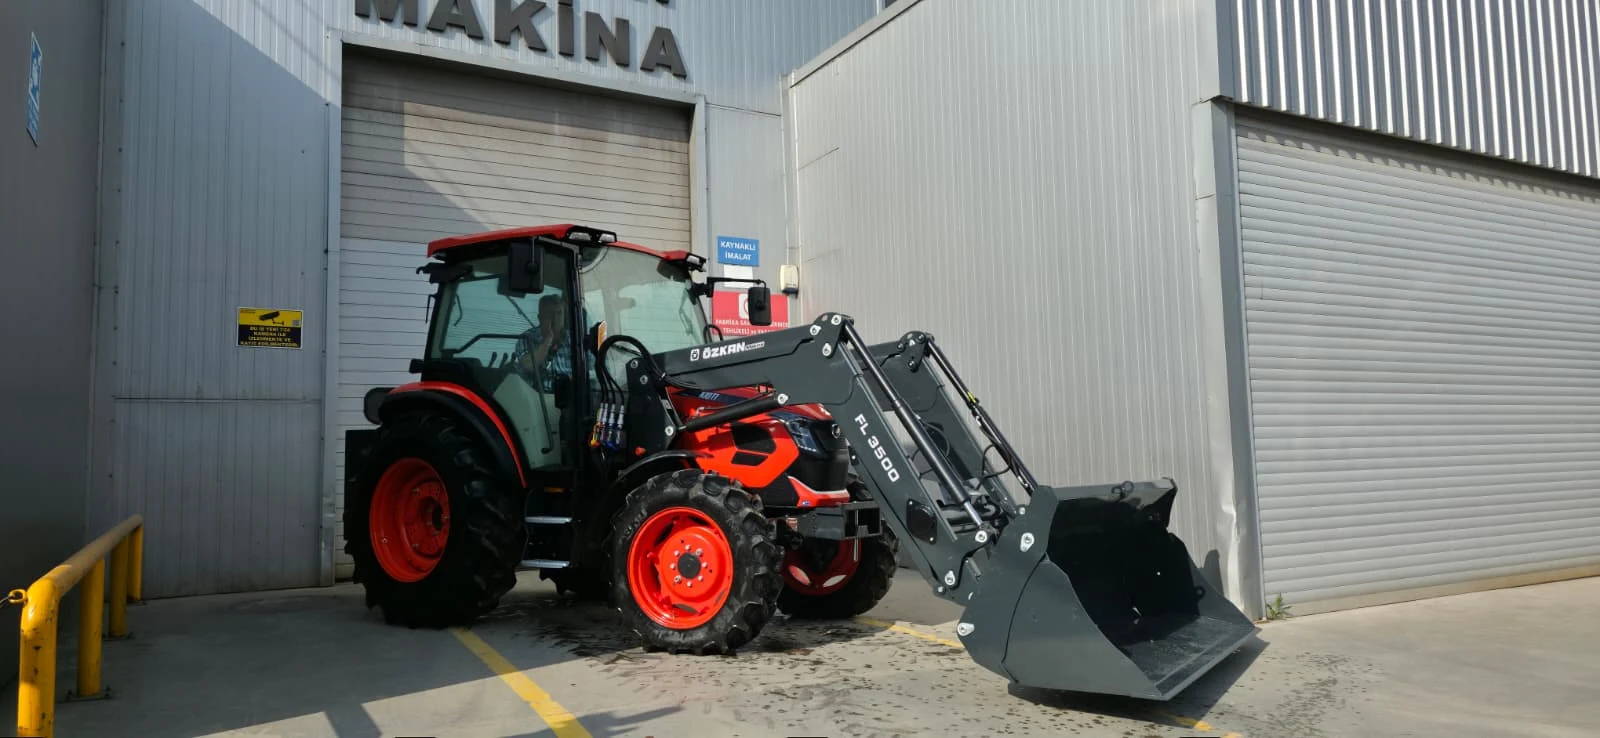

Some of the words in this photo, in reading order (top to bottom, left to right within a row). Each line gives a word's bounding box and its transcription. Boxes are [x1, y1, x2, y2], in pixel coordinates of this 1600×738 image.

[720, 240, 756, 251] KAYNAKLI
[725, 251, 752, 261] İMALAT
[702, 341, 746, 360] ÖZKAN
[854, 413, 869, 436] FL
[867, 435, 900, 483] 3500
